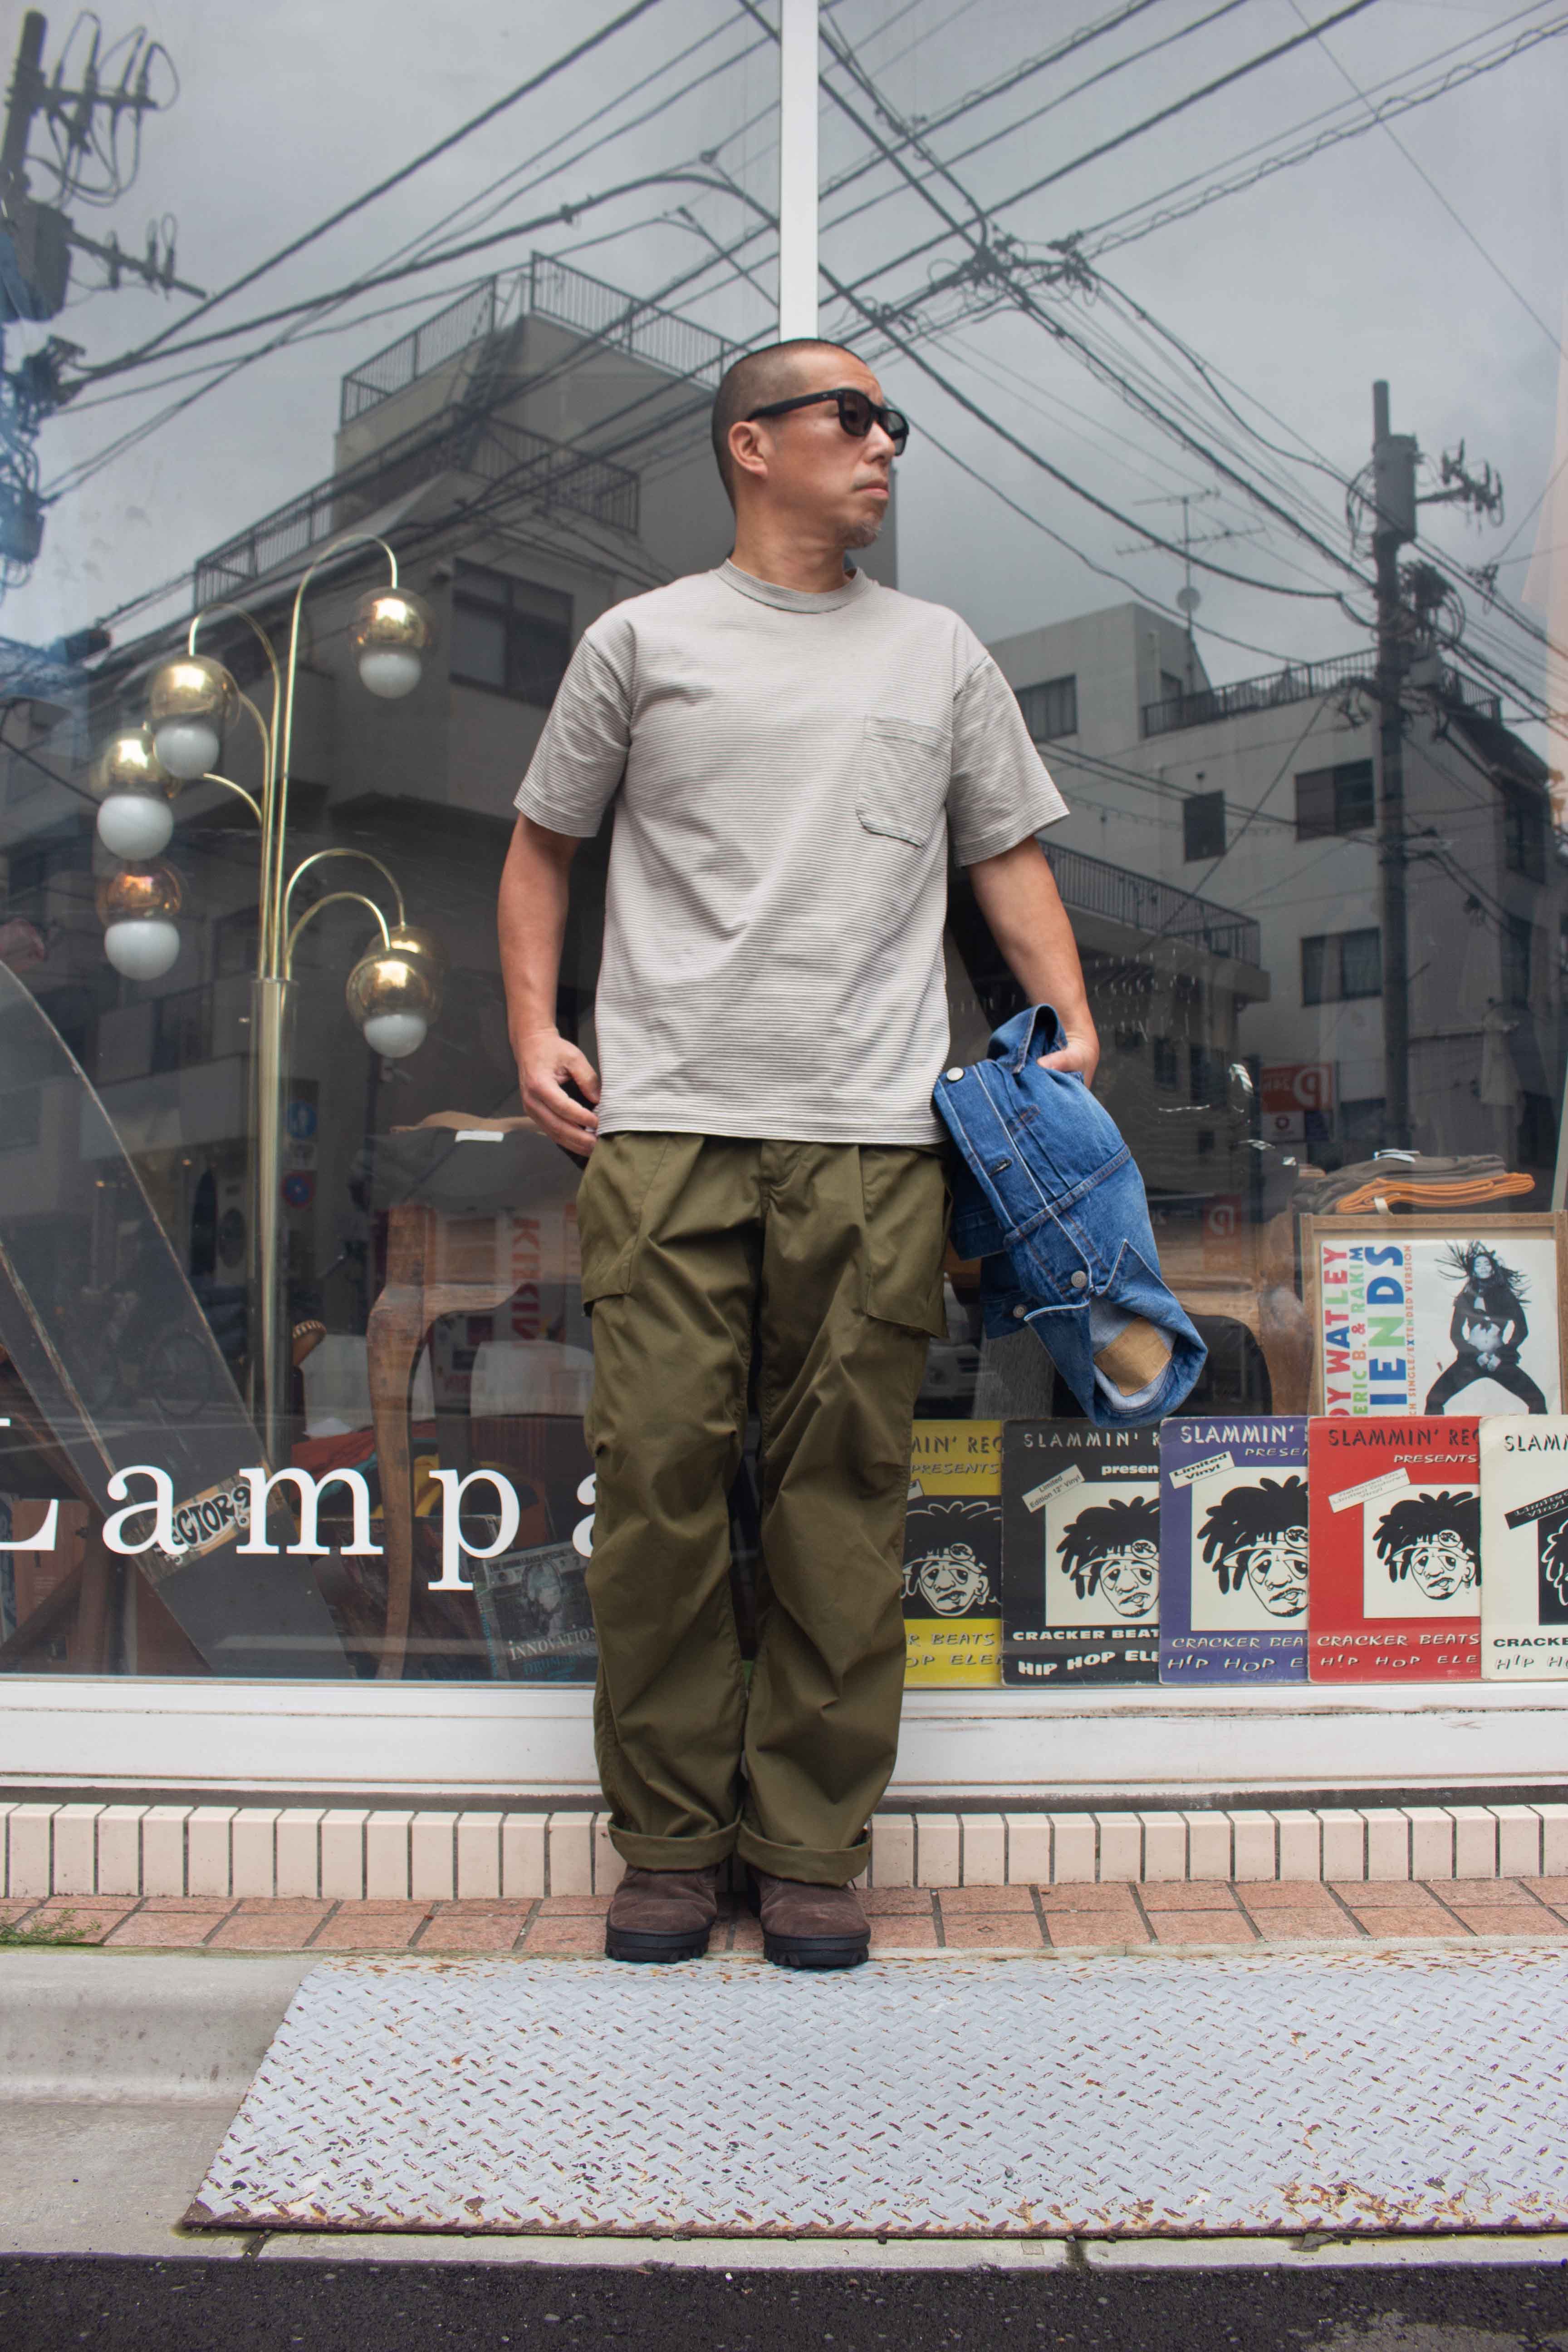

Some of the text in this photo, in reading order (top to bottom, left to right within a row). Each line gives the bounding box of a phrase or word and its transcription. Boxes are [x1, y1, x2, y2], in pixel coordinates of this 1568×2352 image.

[1404, 1245, 1413, 1292] VERSION
[1323, 1247, 1351, 1375] WATLEY
[1349, 1247, 1368, 1415] ERIC B. & RAKIM
[1180, 1425, 1294, 1443] SLAMMIN'
[1328, 1429, 1439, 1446] SLAMMIN'
[1174, 1453, 1227, 1477] Limited
[1393, 1454, 1478, 1463] PRESENTS
[911, 1463, 1000, 1475] PRESENTS
[1185, 1464, 1220, 1479] Vinyl
[1029, 1493, 1053, 1509] Edition
[1064, 1475, 1081, 1487] Vinyl
[1039, 1475, 1063, 1493] Limited
[1528, 1499, 1565, 1517] Vinyl
[931, 1633, 995, 1646] BEATS
[1013, 1630, 1106, 1641] CRACKER
[1172, 1637, 1260, 1649] CRACKER
[1317, 1634, 1481, 1647] CRACKER BEATS
[1018, 1661, 1058, 1676] HIP
[1066, 1651, 1116, 1671] HOP
[1167, 1655, 1209, 1670] HIP
[1224, 1657, 1276, 1672] HOP
[1375, 1656, 1421, 1668] HOP
[1437, 1654, 1478, 1665] ELE
[1496, 1654, 1534, 1670] HIP
